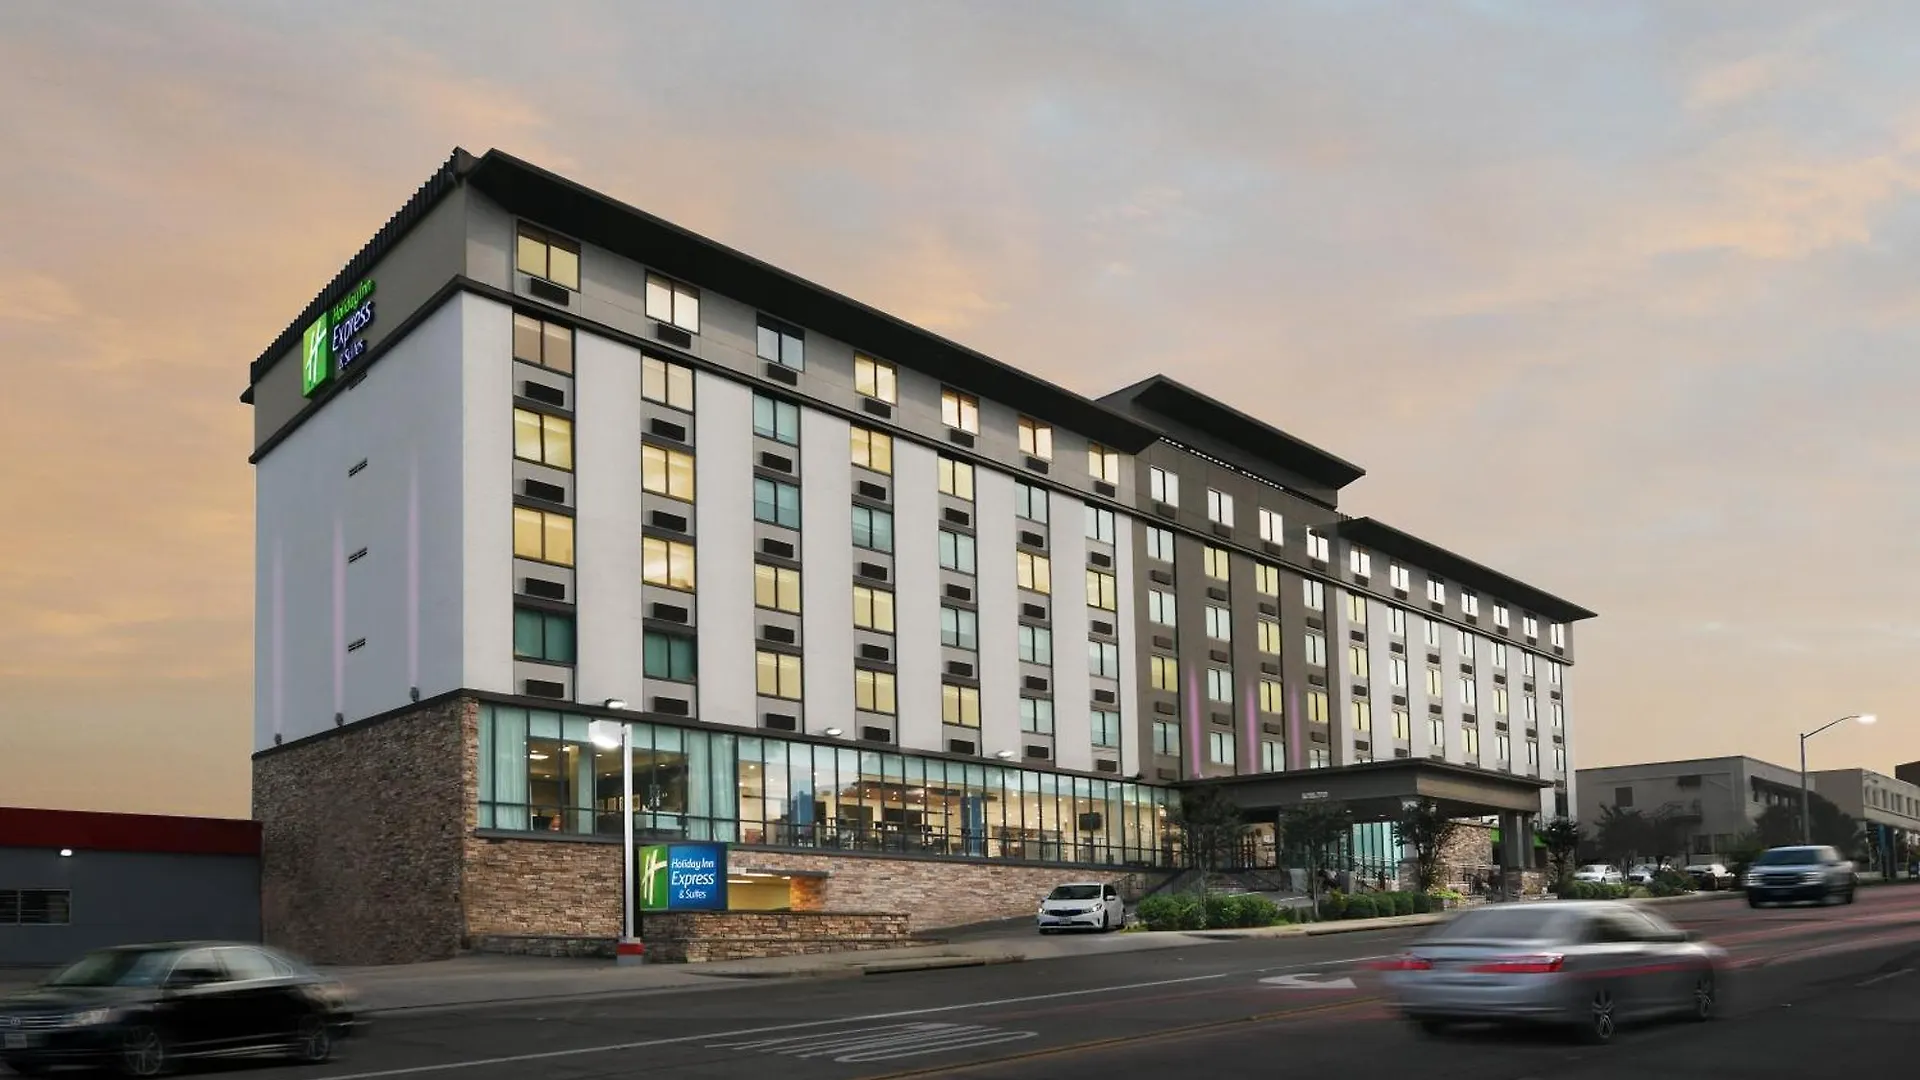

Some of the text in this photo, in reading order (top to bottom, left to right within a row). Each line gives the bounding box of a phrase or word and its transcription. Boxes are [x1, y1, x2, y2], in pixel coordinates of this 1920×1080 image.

[332, 301, 371, 351] Express
[671, 857, 715, 871] Holiday Inn
[671, 871, 715, 889] Express
[678, 889, 707, 899] & Suites
